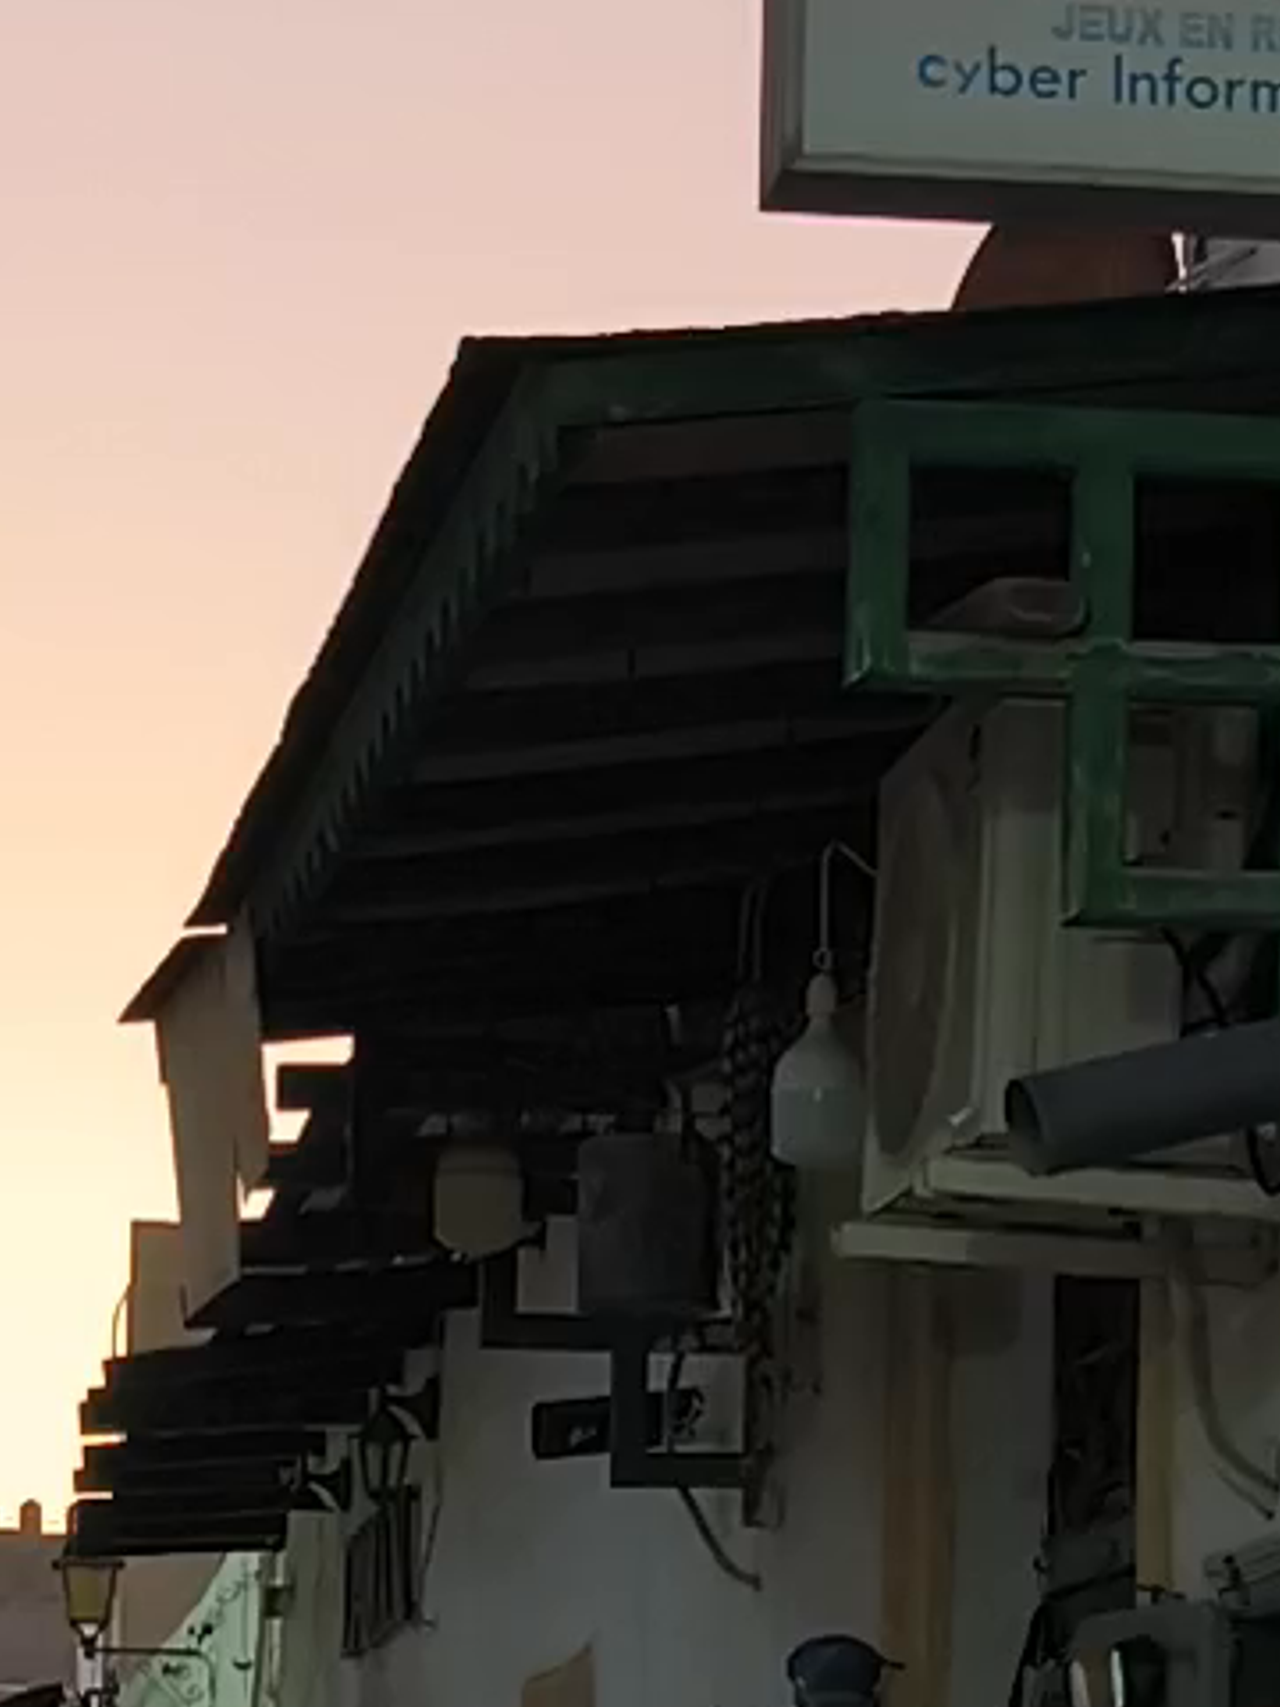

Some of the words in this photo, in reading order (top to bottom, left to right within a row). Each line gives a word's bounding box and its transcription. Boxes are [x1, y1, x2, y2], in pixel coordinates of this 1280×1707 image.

[1051, 3, 1164, 48] JEUX
[1179, 11, 1234, 51] EN
[917, 45, 1087, 99] cyber
